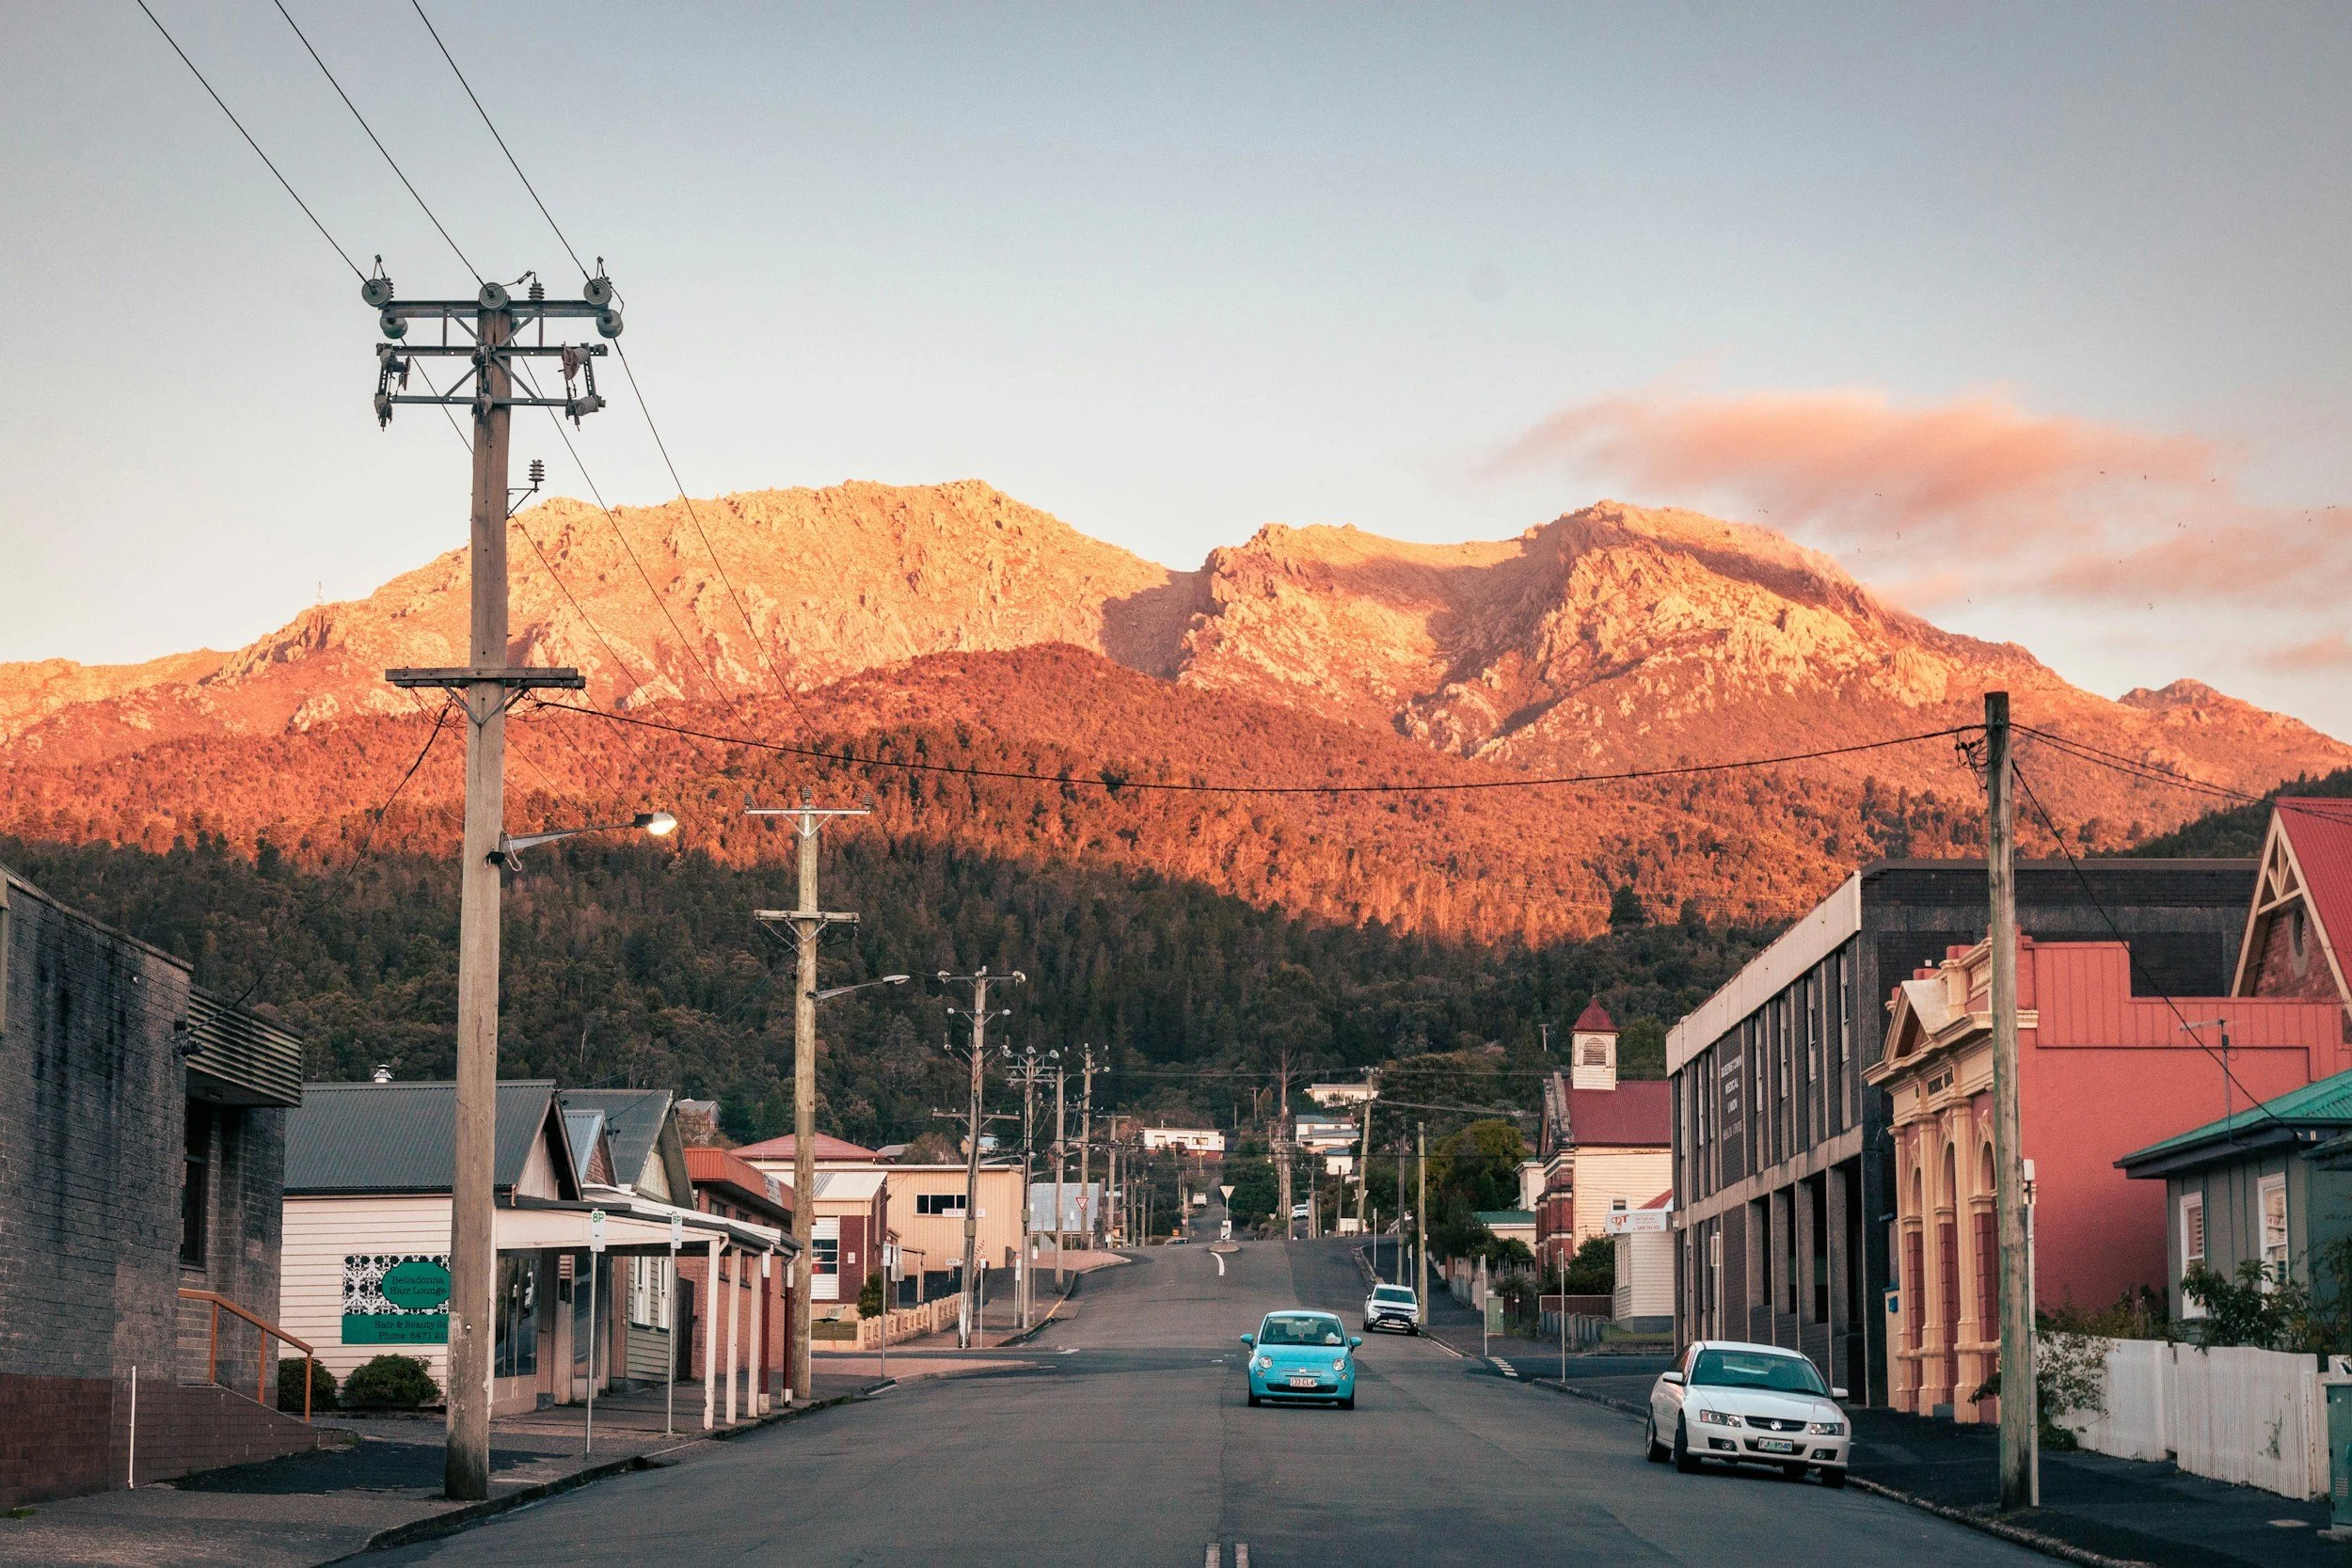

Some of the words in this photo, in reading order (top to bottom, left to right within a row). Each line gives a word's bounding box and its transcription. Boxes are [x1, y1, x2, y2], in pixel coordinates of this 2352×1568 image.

[592, 1212, 604, 1223] 8P
[672, 1215, 681, 1224] 8P
[391, 1275, 445, 1285] Belladonna
[389, 1286, 411, 1295] Hair
[413, 1286, 447, 1296] Lounge
[374, 1321, 395, 1329] Hair
[396, 1321, 404, 1329] &
[405, 1321, 436, 1330] Beauty
[437, 1321, 448, 1329] Sa
